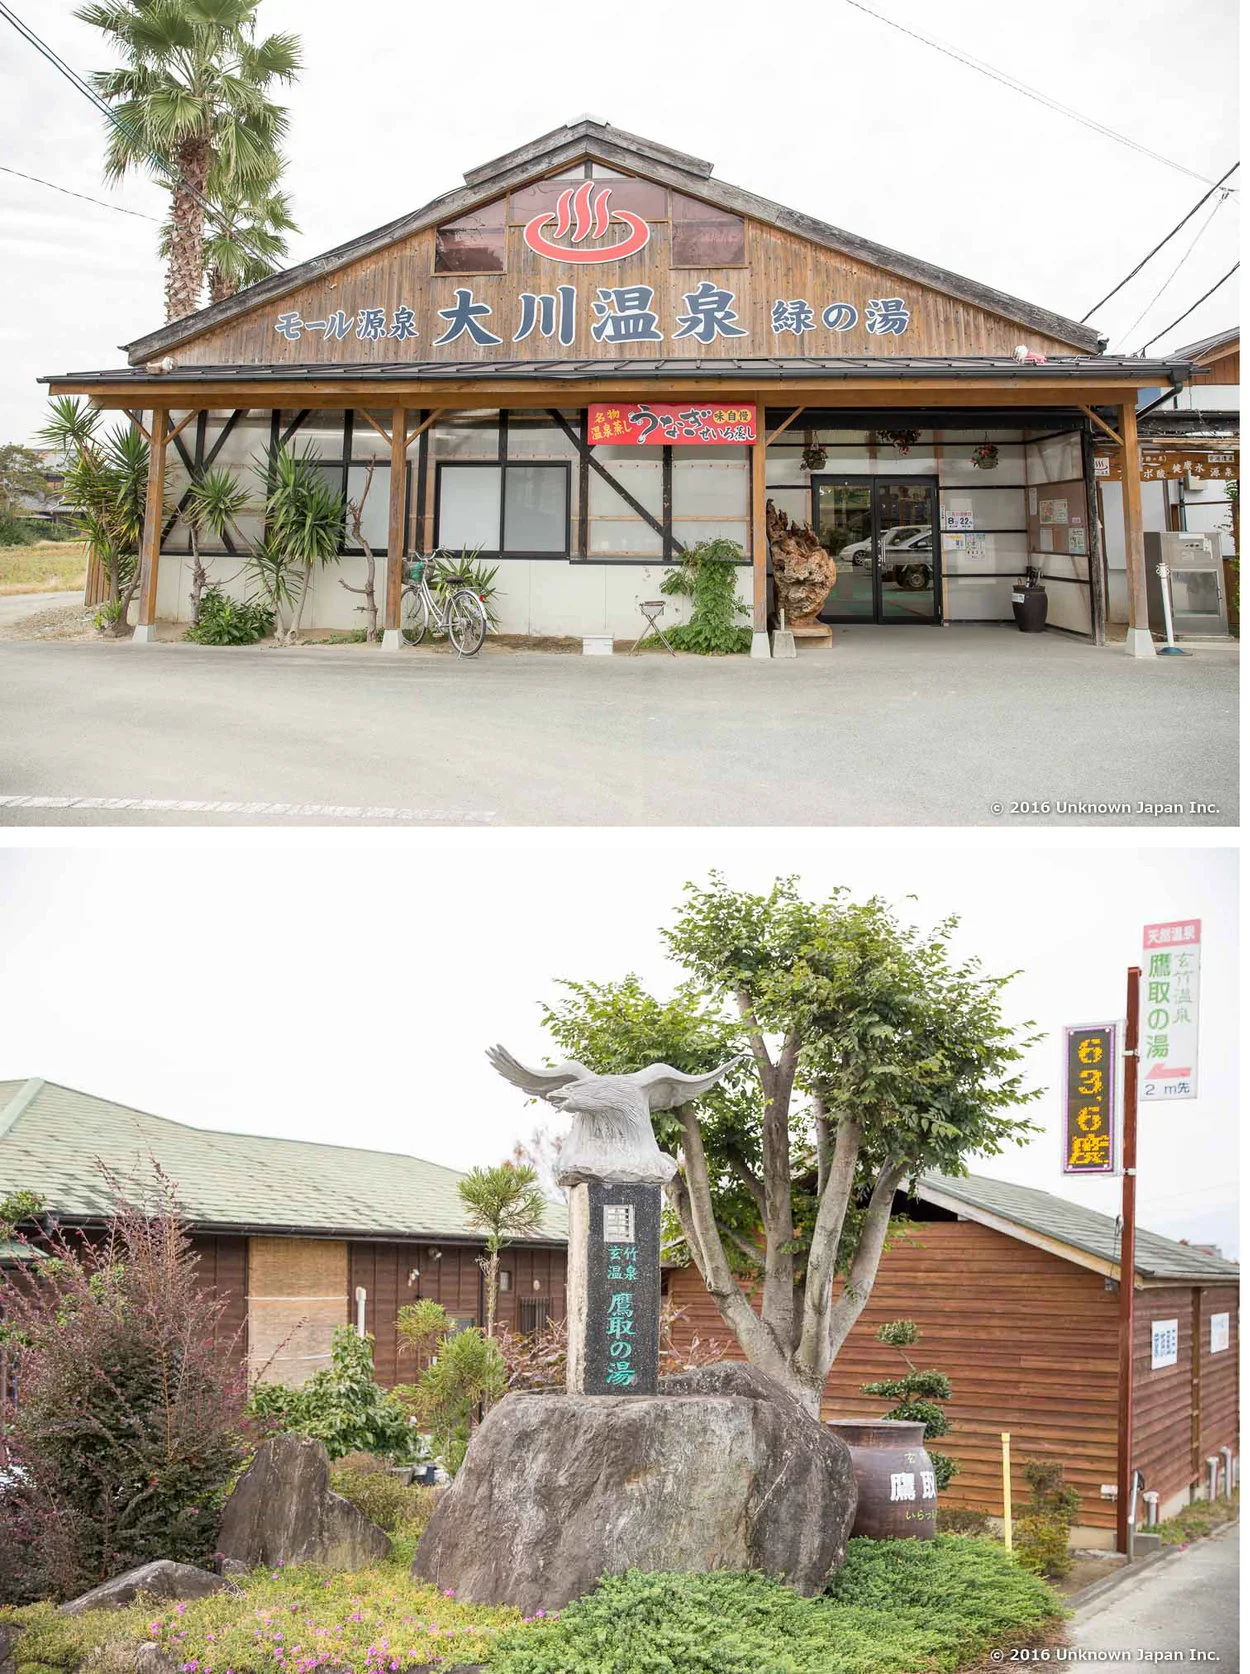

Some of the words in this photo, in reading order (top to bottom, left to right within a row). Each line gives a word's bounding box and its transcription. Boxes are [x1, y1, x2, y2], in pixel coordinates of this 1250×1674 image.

[274, 305, 420, 343] モール源泉
[433, 280, 750, 348] 大川温泉
[770, 297, 910, 337] 緑の湯
[628, 404, 713, 444] うなぎ
[699, 425, 757, 440] せいろ蒸し
[1147, 952, 1172, 1060] 鷹取の湯
[605, 1291, 636, 1387] 鷹取の湯
